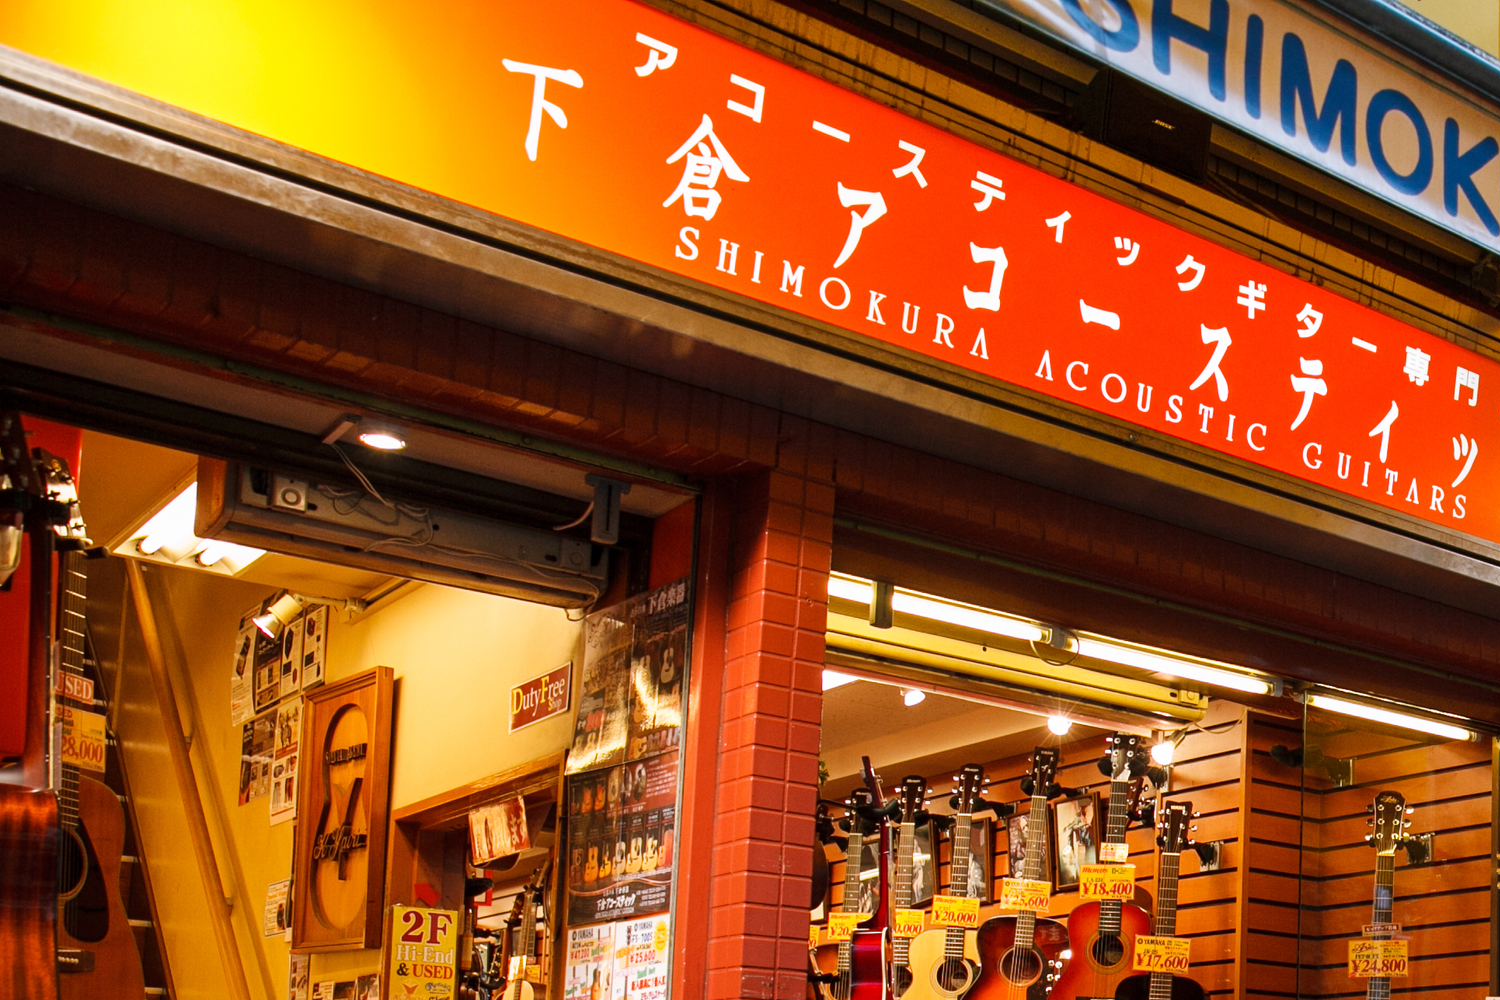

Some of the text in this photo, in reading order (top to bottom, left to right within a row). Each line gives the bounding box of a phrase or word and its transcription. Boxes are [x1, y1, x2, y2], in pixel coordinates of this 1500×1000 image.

[674, 226, 1467, 520] SHIMOKURA ACOUSTIC GUITARS
[1082, 880, 1133, 896] ¥18,400
[933, 909, 977, 924] ¥20,000
[400, 910, 453, 945] 2F
[1144, 938, 1166, 946] YAMAHA
[395, 944, 454, 965] Hi-End
[1135, 953, 1189, 970] ¥17,600
[396, 963, 454, 980] & USED
[1351, 958, 1406, 974] ¥24,800
